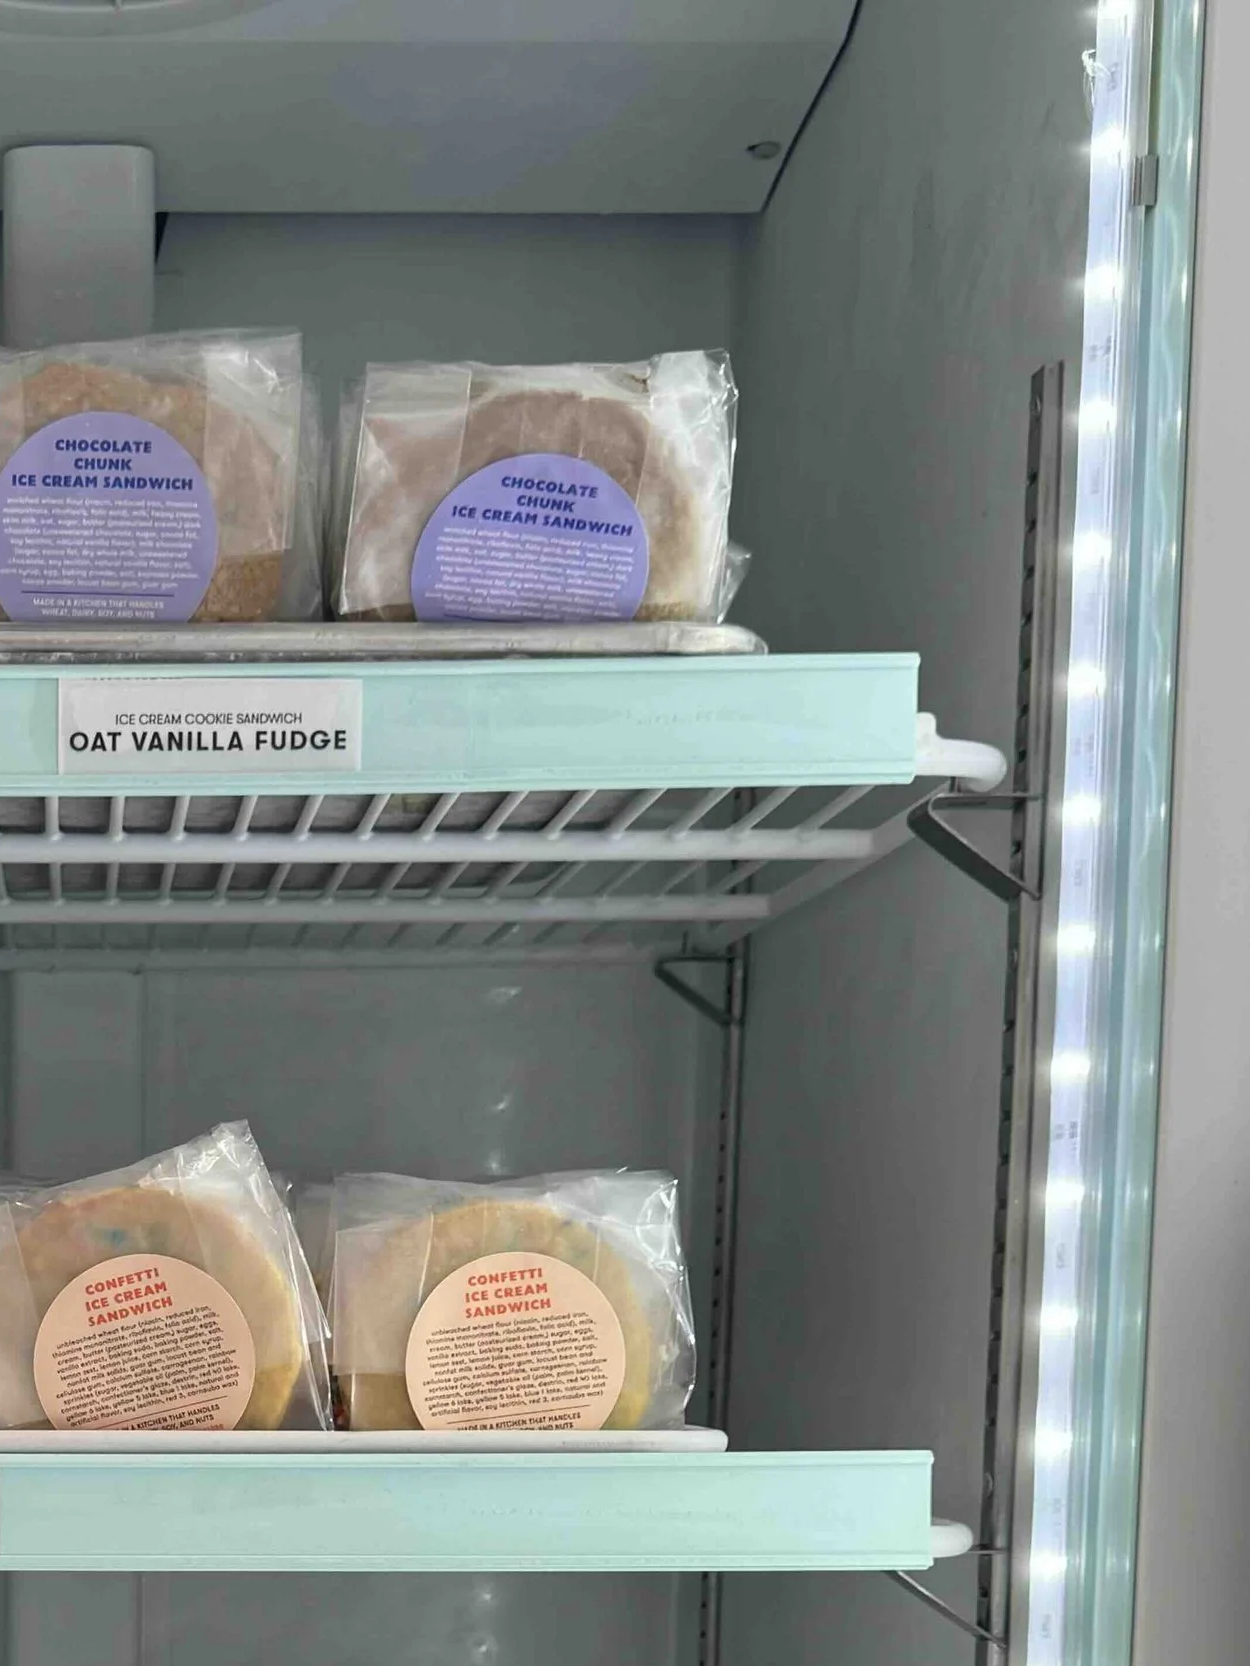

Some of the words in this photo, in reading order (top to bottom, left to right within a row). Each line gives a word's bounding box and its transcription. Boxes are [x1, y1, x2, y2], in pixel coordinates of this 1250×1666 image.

[55, 439, 152, 453] CHOCOLATE
[74, 458, 132, 471] CHUNK
[12, 475, 36, 486] ICE
[42, 475, 97, 488] CREAM
[103, 477, 193, 490] SANDWICH
[501, 476, 599, 498] CHOCOLATE
[517, 495, 576, 512] CHUNK
[452, 506, 476, 518] ICE
[482, 509, 537, 525] CREAM
[542, 516, 632, 536] SANDWICH
[115, 714, 136, 725] ICE
[139, 714, 181, 725] CREAM
[185, 713, 233, 725] COOKIE
[236, 713, 302, 724] SANDWICH
[69, 732, 121, 751] OAT
[131, 731, 243, 751] VANILLA
[255, 730, 347, 750] FUDGE
[85, 1268, 159, 1295] CONFETTI
[468, 1268, 543, 1286] CONFETTI
[86, 1299, 109, 1312] ICE
[114, 1282, 167, 1304] CREAM
[465, 1291, 488, 1303] ICE
[494, 1283, 548, 1299] CREAM
[88, 1296, 173, 1327] SANDWICH
[466, 1299, 551, 1319] SANDWICH
